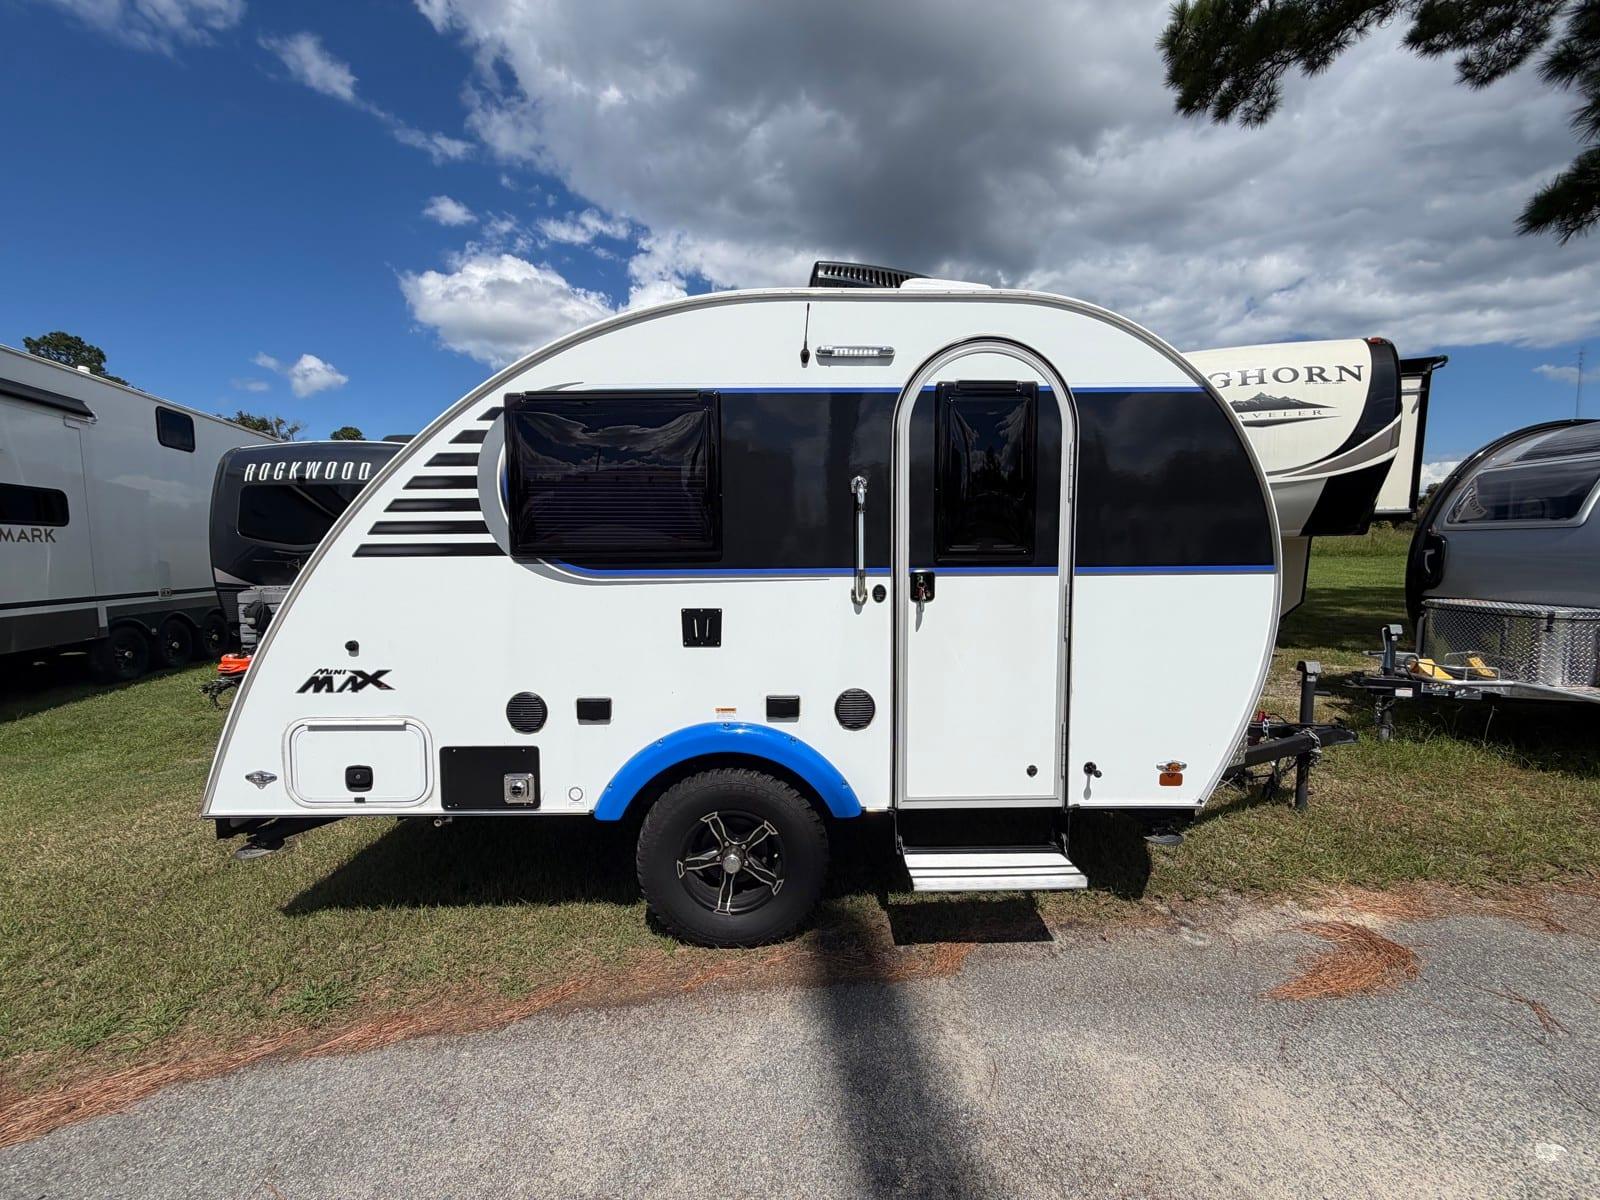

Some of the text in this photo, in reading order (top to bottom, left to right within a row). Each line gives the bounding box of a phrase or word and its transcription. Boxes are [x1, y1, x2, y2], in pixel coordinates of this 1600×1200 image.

[1208, 364, 1364, 388] GHORN
[244, 461, 371, 481] ROCKWOOD
[0, 527, 56, 543] MARK
[296, 669, 396, 693] MAX
